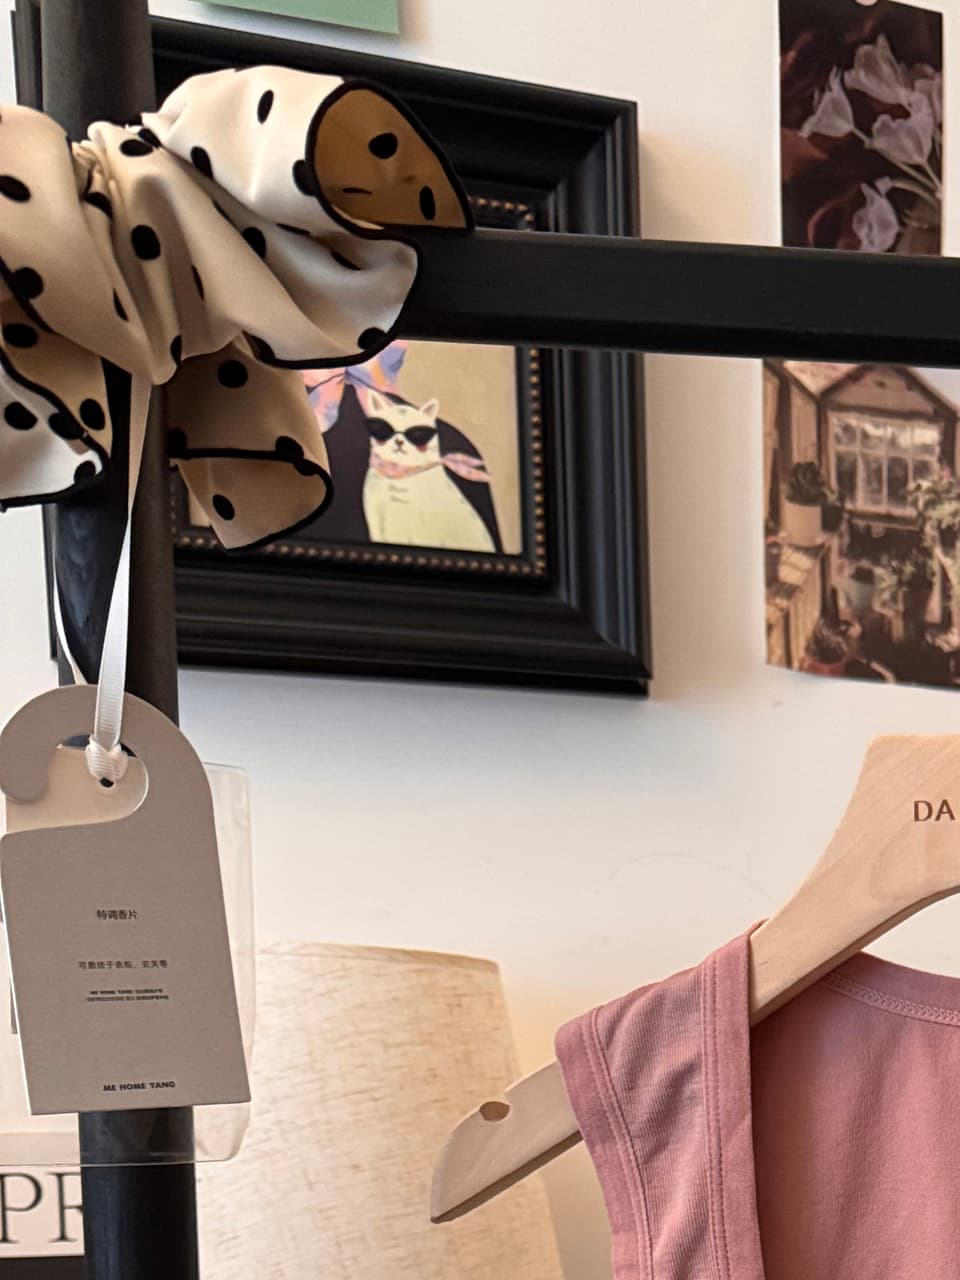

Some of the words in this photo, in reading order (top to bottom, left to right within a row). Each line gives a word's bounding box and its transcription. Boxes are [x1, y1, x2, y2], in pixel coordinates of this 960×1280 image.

[913, 799, 956, 822] DA
[120, 1082, 146, 1090] HOME
[149, 1081, 176, 1089] YANG
